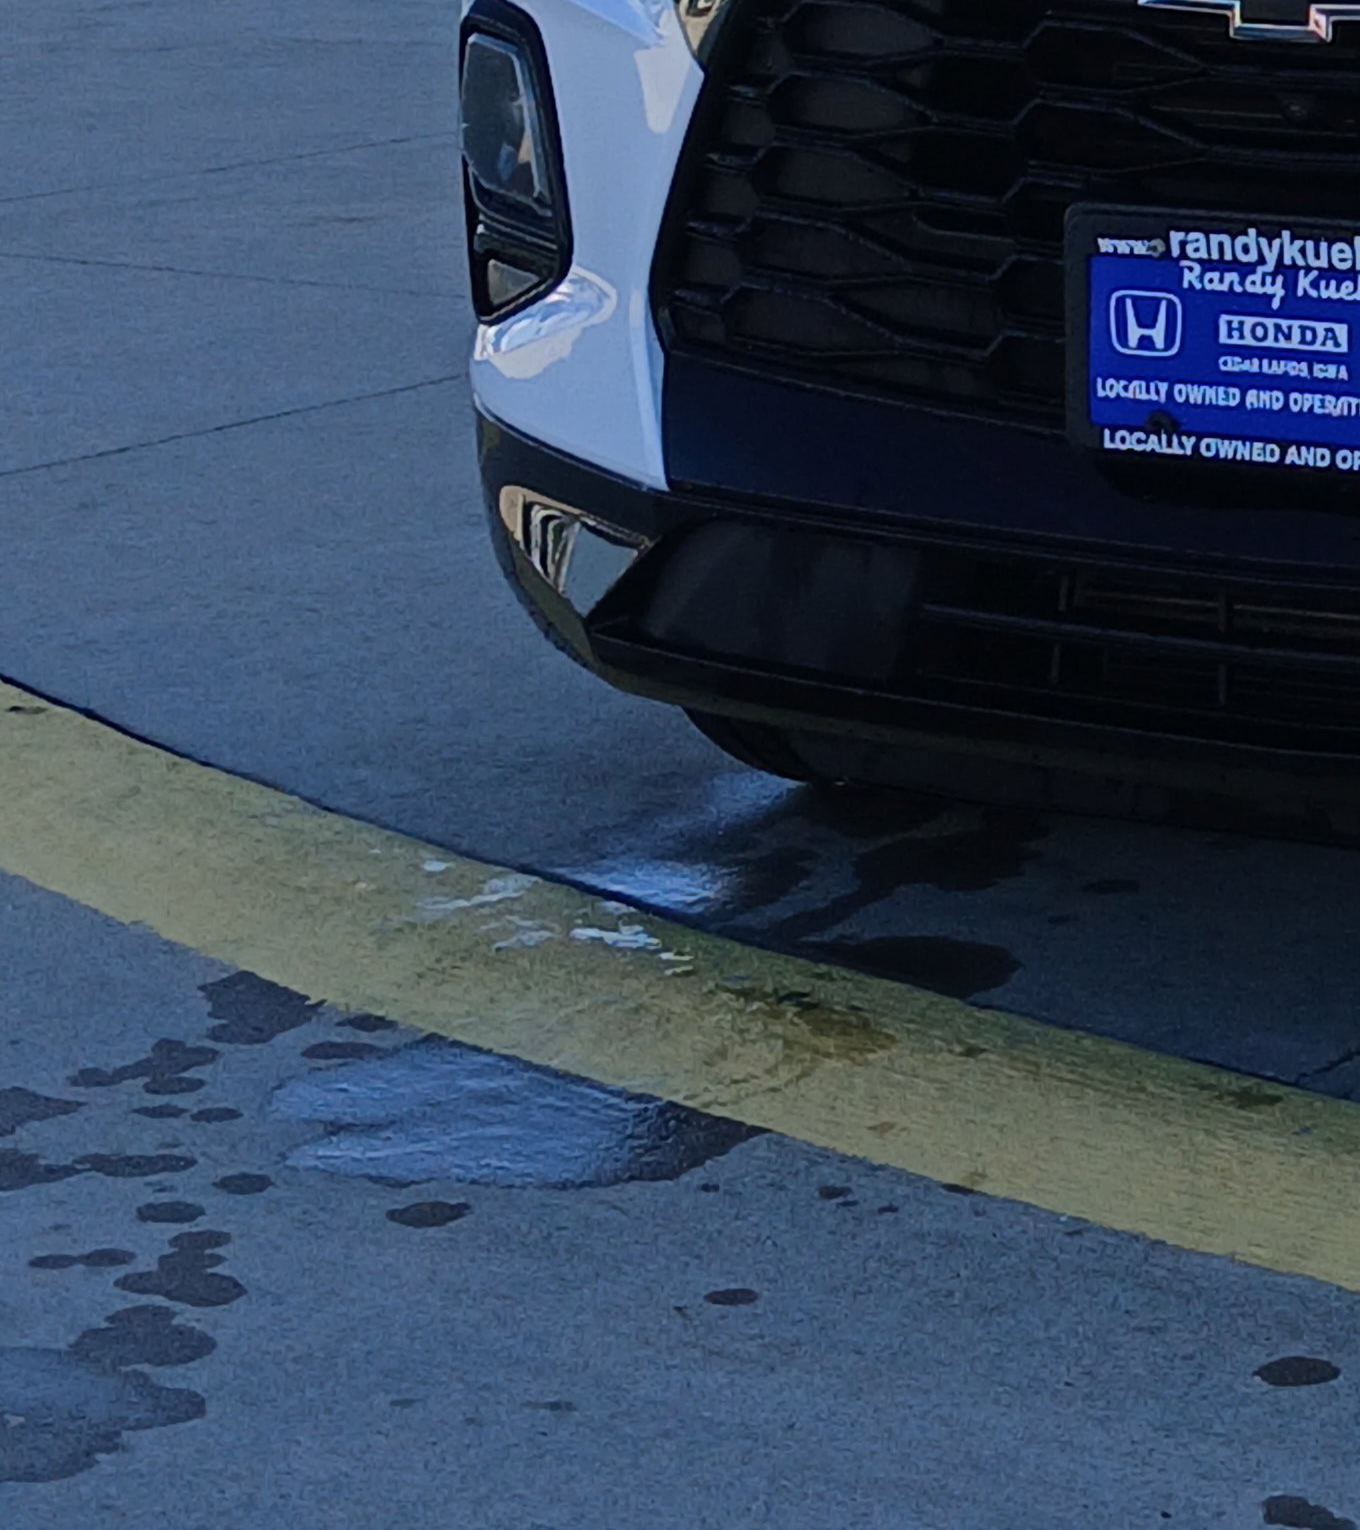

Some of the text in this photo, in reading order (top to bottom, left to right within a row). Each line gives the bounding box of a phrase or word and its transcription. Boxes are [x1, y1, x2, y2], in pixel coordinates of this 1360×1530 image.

[1179, 260, 1286, 310] Randy
[1225, 319, 1342, 349] HONDA
[1096, 377, 1169, 404] LOCALLY
[1173, 383, 1241, 407] OWNED
[1245, 389, 1284, 411] AND
[1103, 428, 1197, 456] LOCALLY
[1200, 437, 1281, 463] OWNED
[1284, 444, 1331, 468] AND
